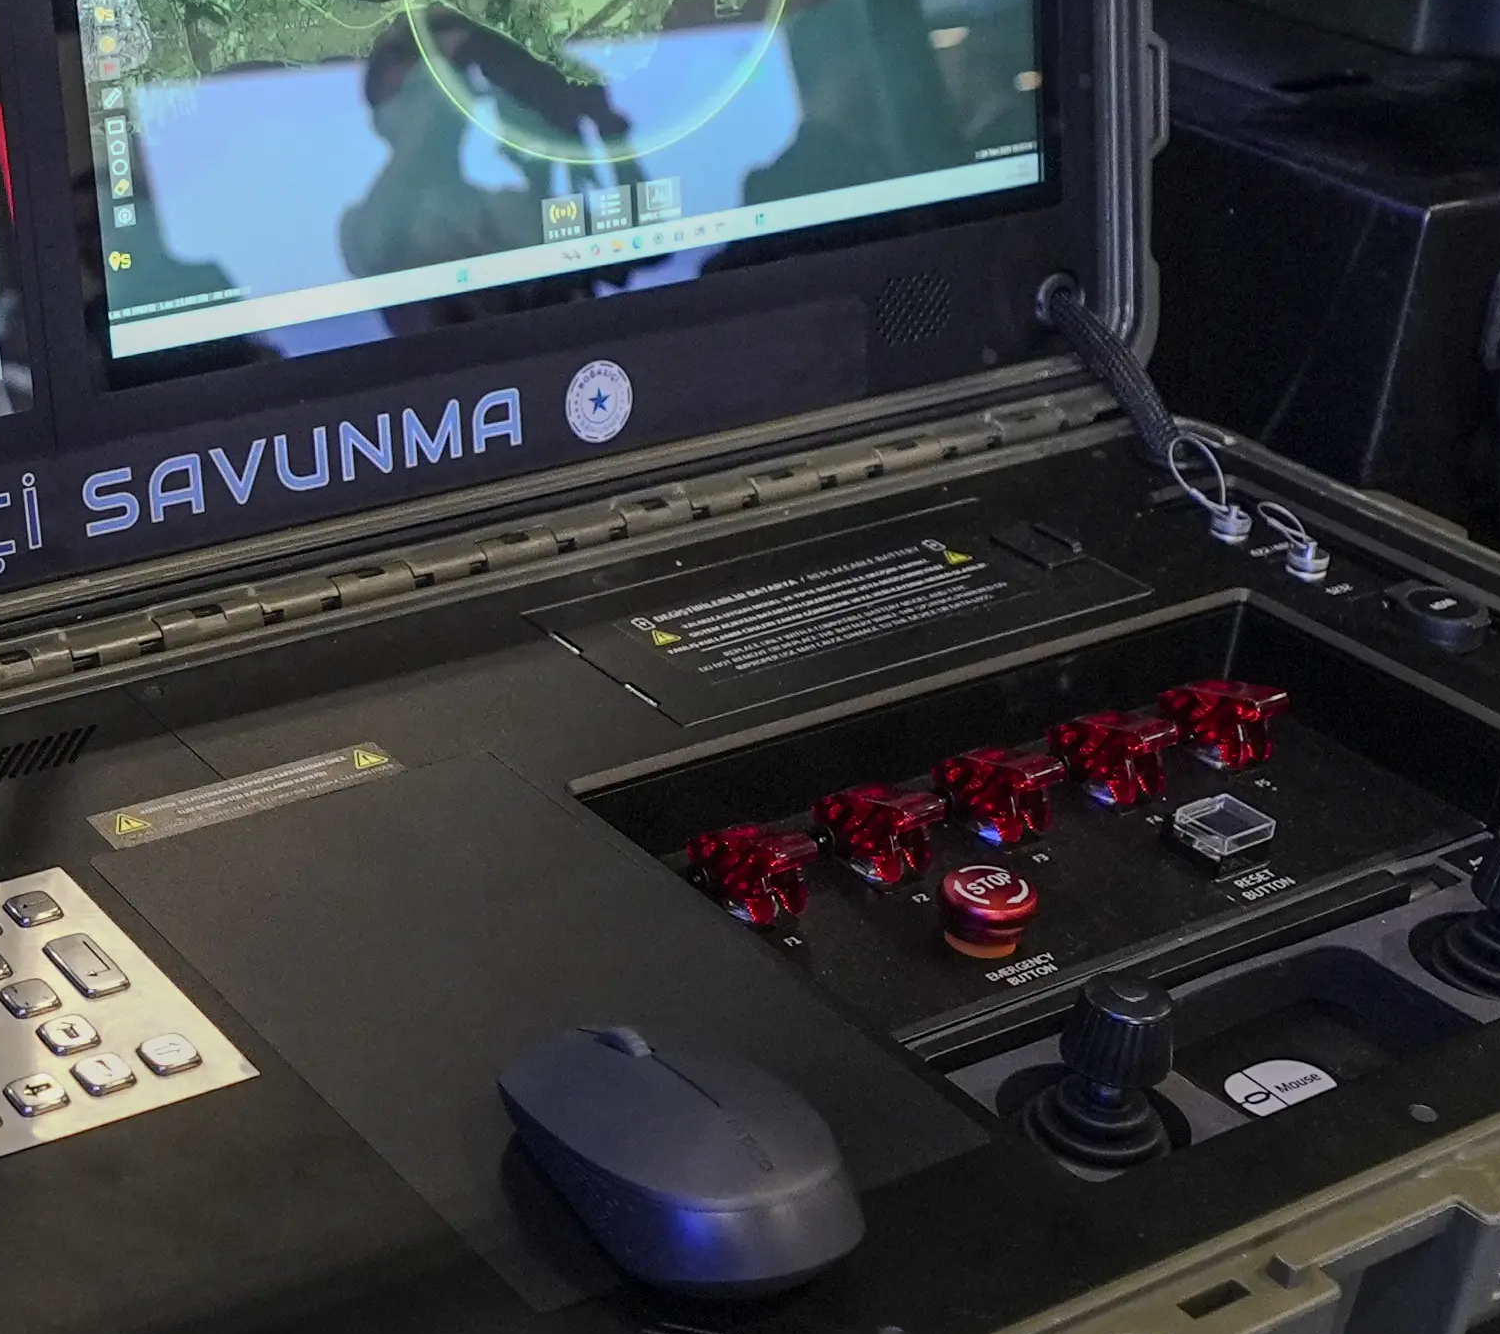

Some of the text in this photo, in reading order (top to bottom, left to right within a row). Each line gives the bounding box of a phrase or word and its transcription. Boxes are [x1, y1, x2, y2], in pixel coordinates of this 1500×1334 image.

[83, 386, 525, 538] SAVUNMA
[966, 871, 1012, 895] STOP
[1234, 868, 1276, 889] RESET
[1241, 875, 1297, 901] BUTTON
[912, 893, 930, 904] F2
[783, 935, 802, 947] F1
[984, 951, 1055, 983] EMERGENCY
[1006, 962, 1060, 987] BUTTON
[1274, 1070, 1323, 1095] Mouse
